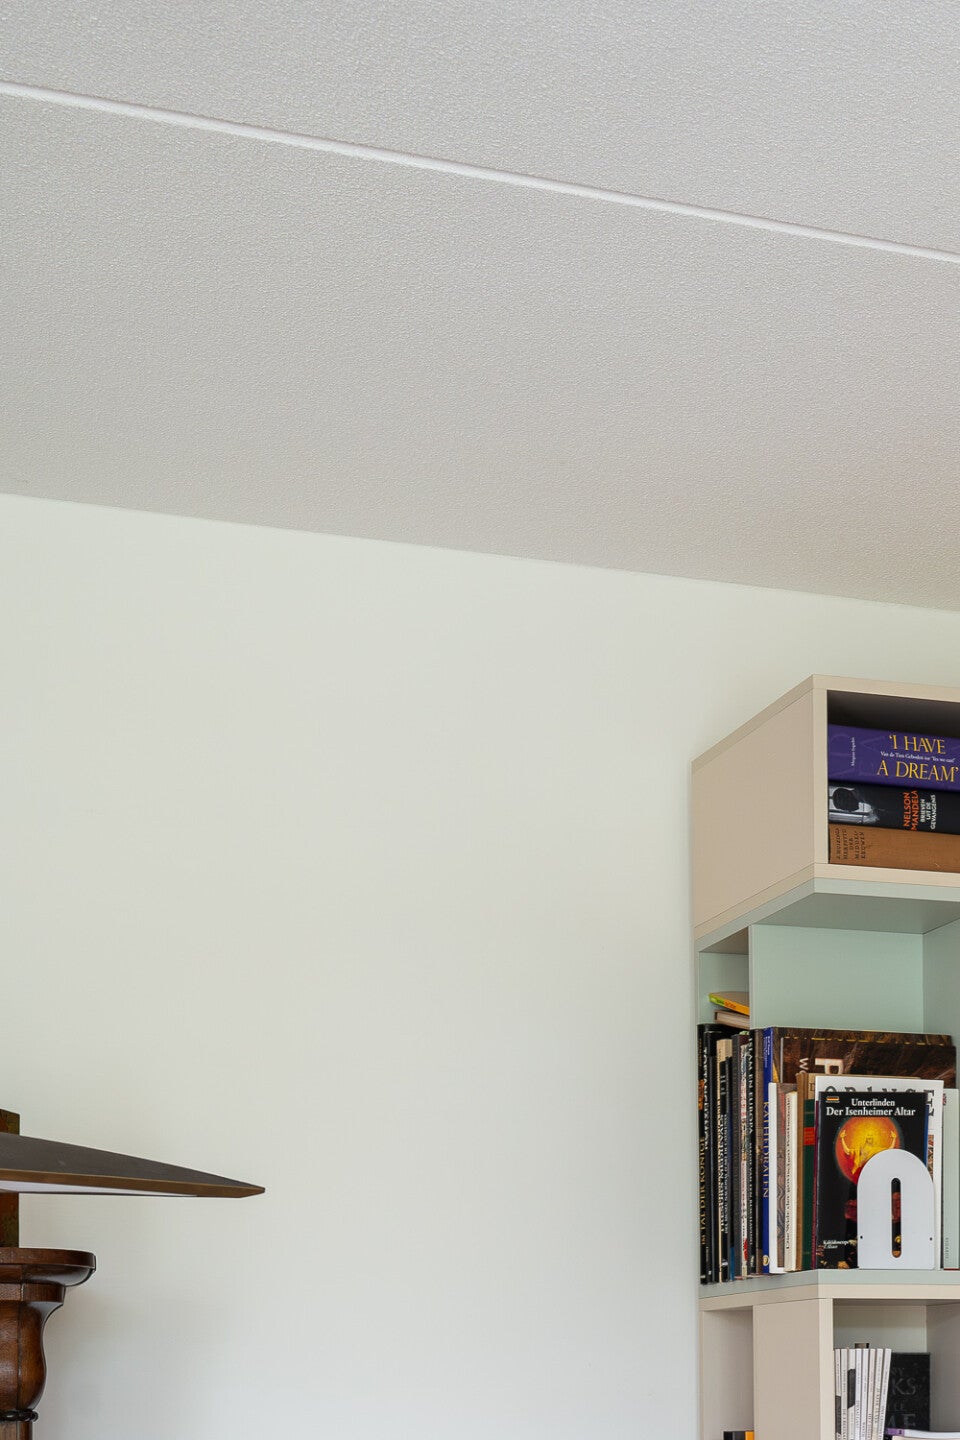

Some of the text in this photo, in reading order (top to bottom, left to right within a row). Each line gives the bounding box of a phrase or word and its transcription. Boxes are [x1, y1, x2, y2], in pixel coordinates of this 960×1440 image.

[904, 735, 947, 755] HAVE
[877, 759, 889, 777] A
[902, 791, 911, 827] NELSON
[910, 790, 919, 831] MANDELA
[826, 1106, 916, 1117] Der Isenheimer Altar
[851, 1097, 896, 1107] Unterlinden
